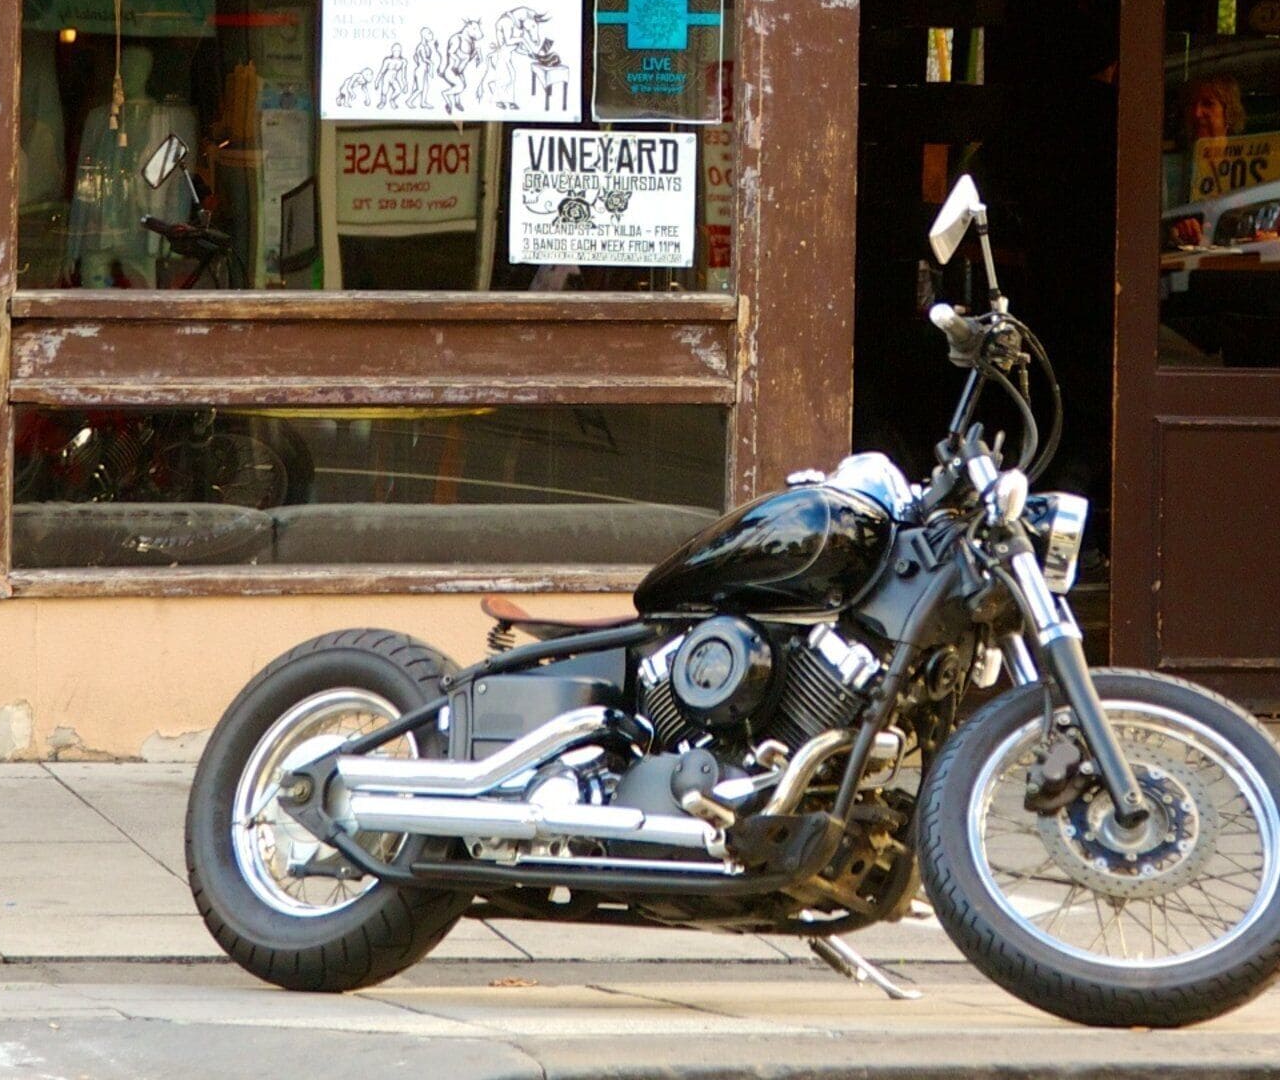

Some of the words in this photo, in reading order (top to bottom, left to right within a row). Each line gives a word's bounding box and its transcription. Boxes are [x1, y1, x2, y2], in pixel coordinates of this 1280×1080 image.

[353, 29, 397, 39] BUCKS
[643, 58, 671, 70] LIVE
[627, 73, 653, 82] EVERY
[656, 73, 685, 82] FRIDAY
[528, 136, 679, 174] VINEYARD
[524, 174, 600, 191] GRAVEYARD
[605, 175, 682, 191] THURSDAYS
[536, 223, 575, 235] ACLAND
[597, 224, 611, 236] ST
[614, 224, 642, 237] KILDA
[654, 225, 679, 237] FREE
[522, 239, 529, 250] 3
[533, 239, 568, 251] BANDS
[570, 239, 596, 251] EACH
[601, 240, 624, 252] WEEK
[629, 240, 655, 252] FROM
